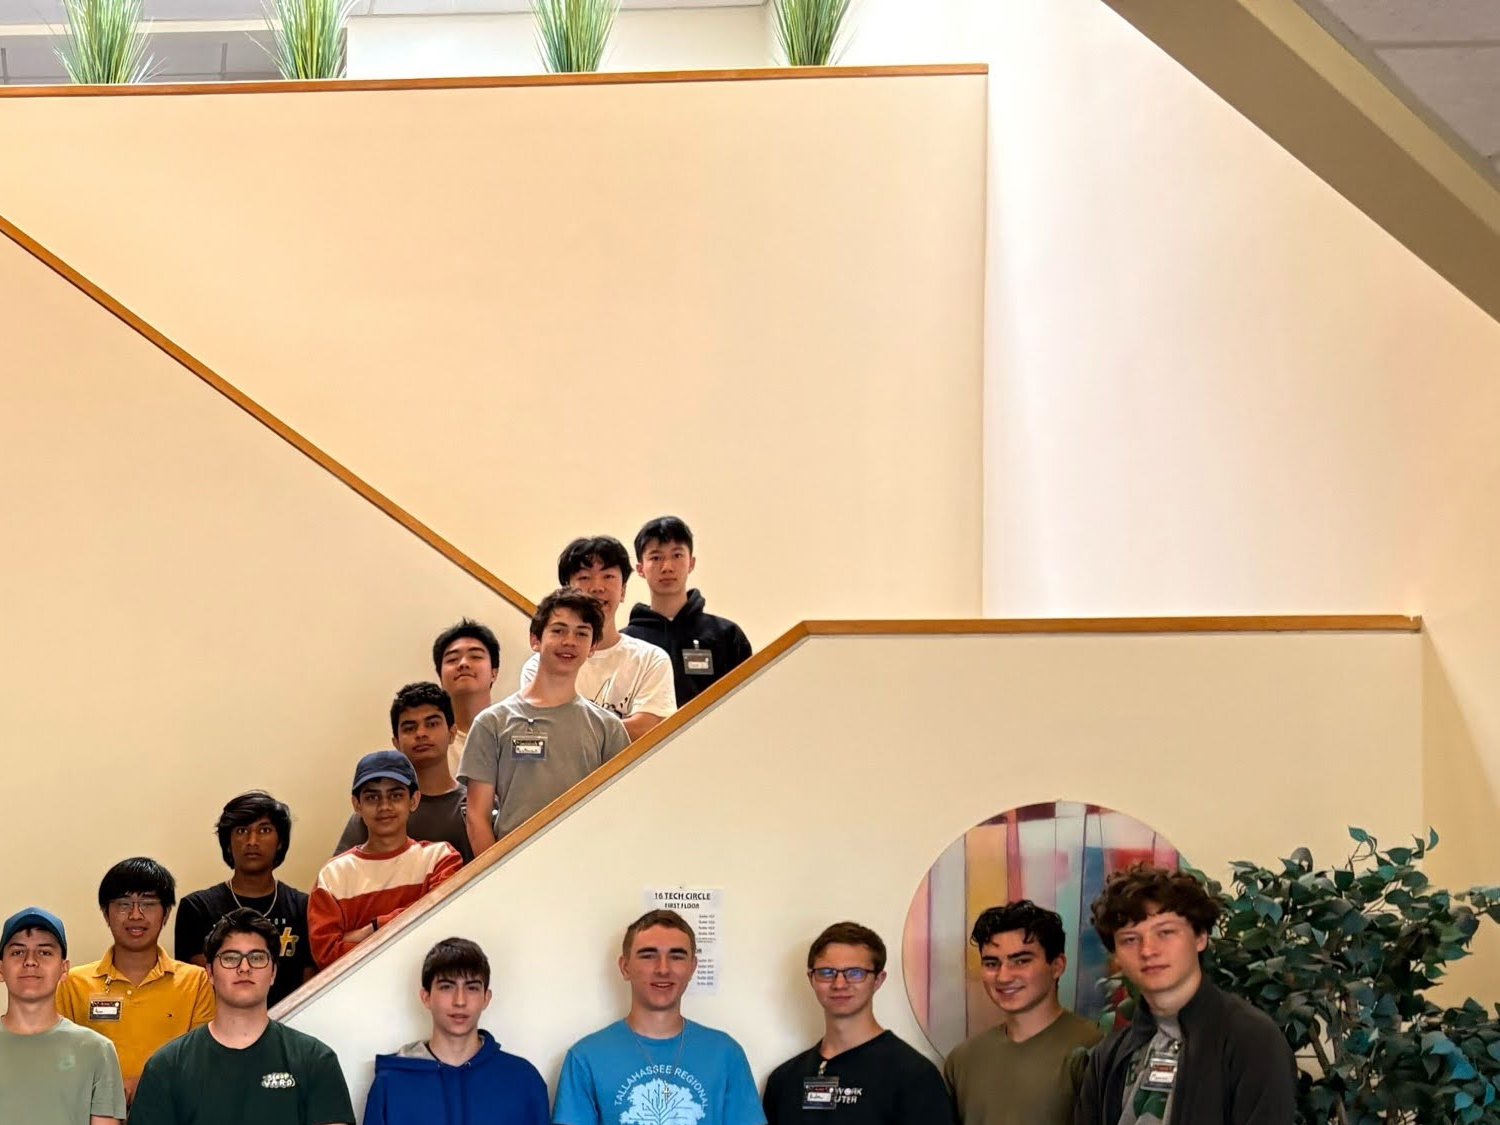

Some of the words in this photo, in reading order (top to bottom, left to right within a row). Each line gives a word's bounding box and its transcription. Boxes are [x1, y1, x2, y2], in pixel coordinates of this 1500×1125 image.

[654, 892, 663, 900] 16
[664, 892, 684, 901] TECH
[685, 892, 711, 901] CIRCLE
[613, 1064, 673, 1107] TALLAHASSEE
[673, 1067, 709, 1108] REGIONAL
